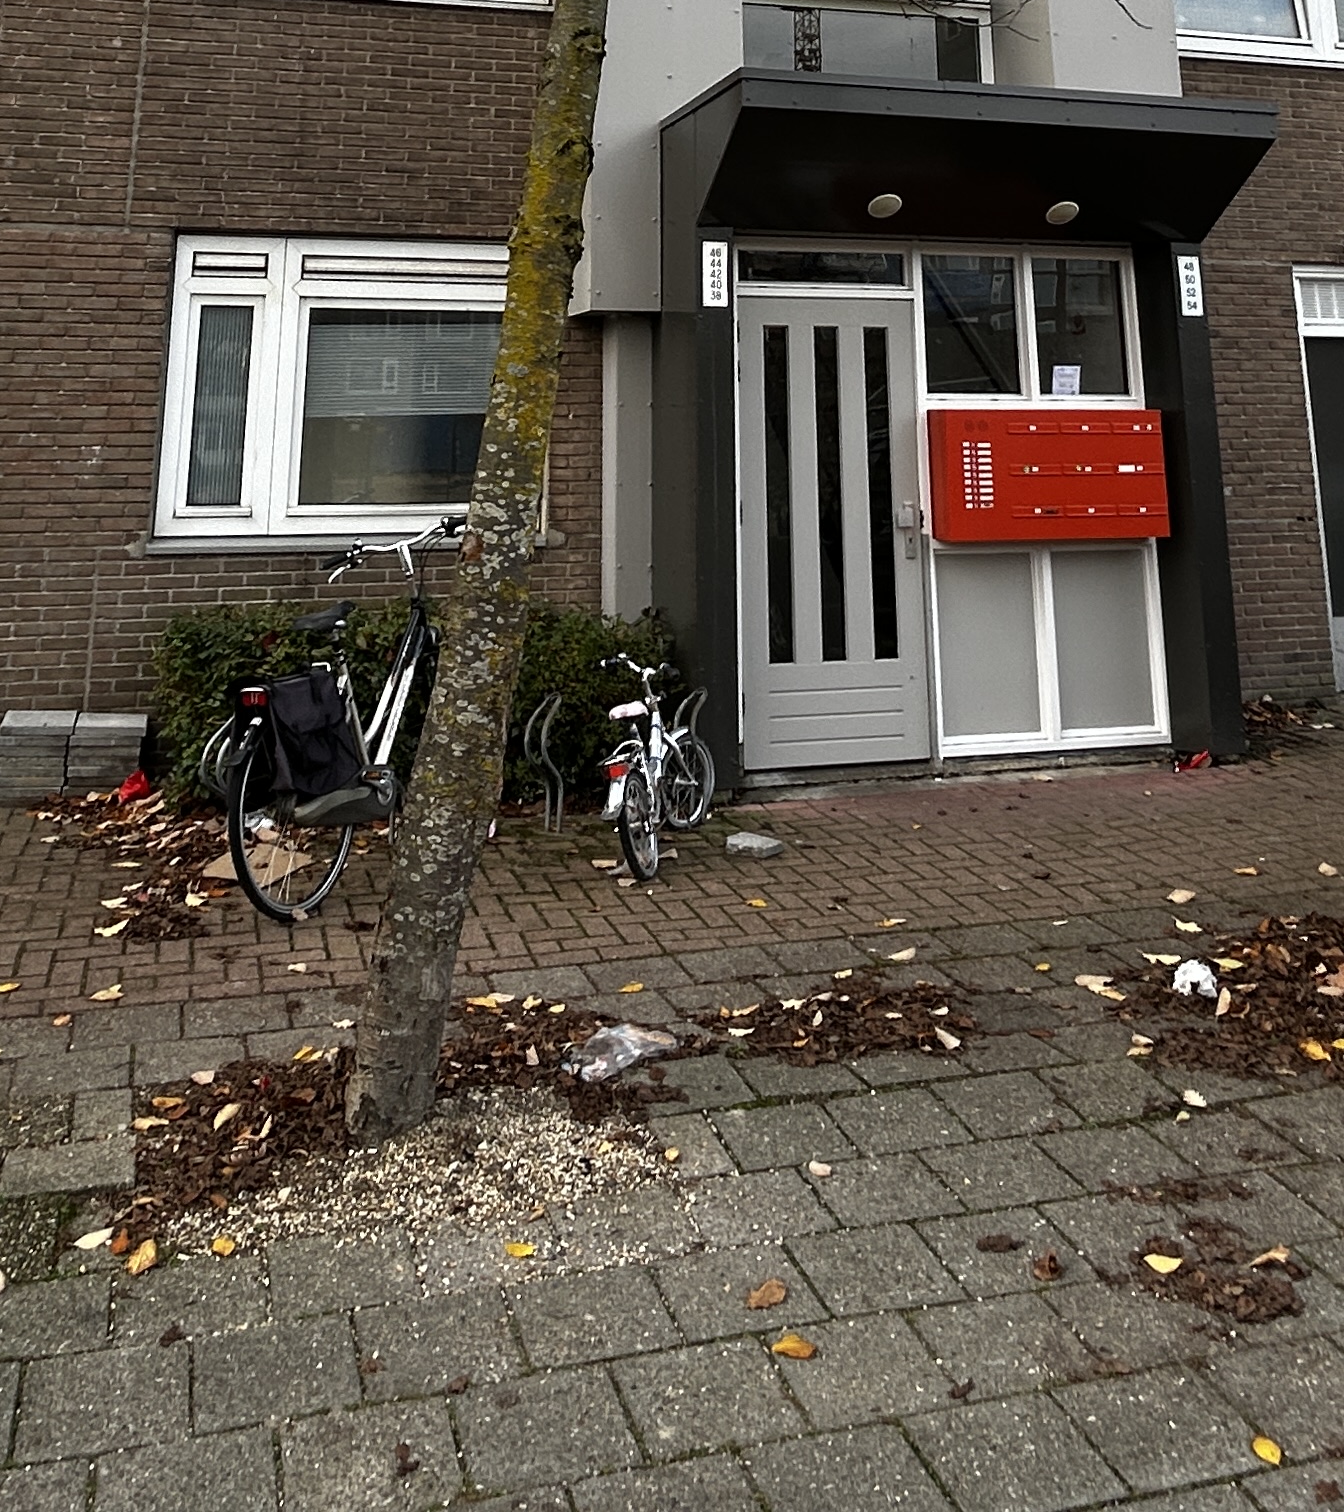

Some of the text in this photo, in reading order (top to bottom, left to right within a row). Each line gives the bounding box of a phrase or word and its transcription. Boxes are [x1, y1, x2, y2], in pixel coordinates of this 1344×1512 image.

[710, 258, 722, 268] 44
[709, 269, 722, 279] 42
[710, 279, 722, 289] 40
[1186, 287, 1197, 298] 52
[1187, 300, 1198, 311] 54
